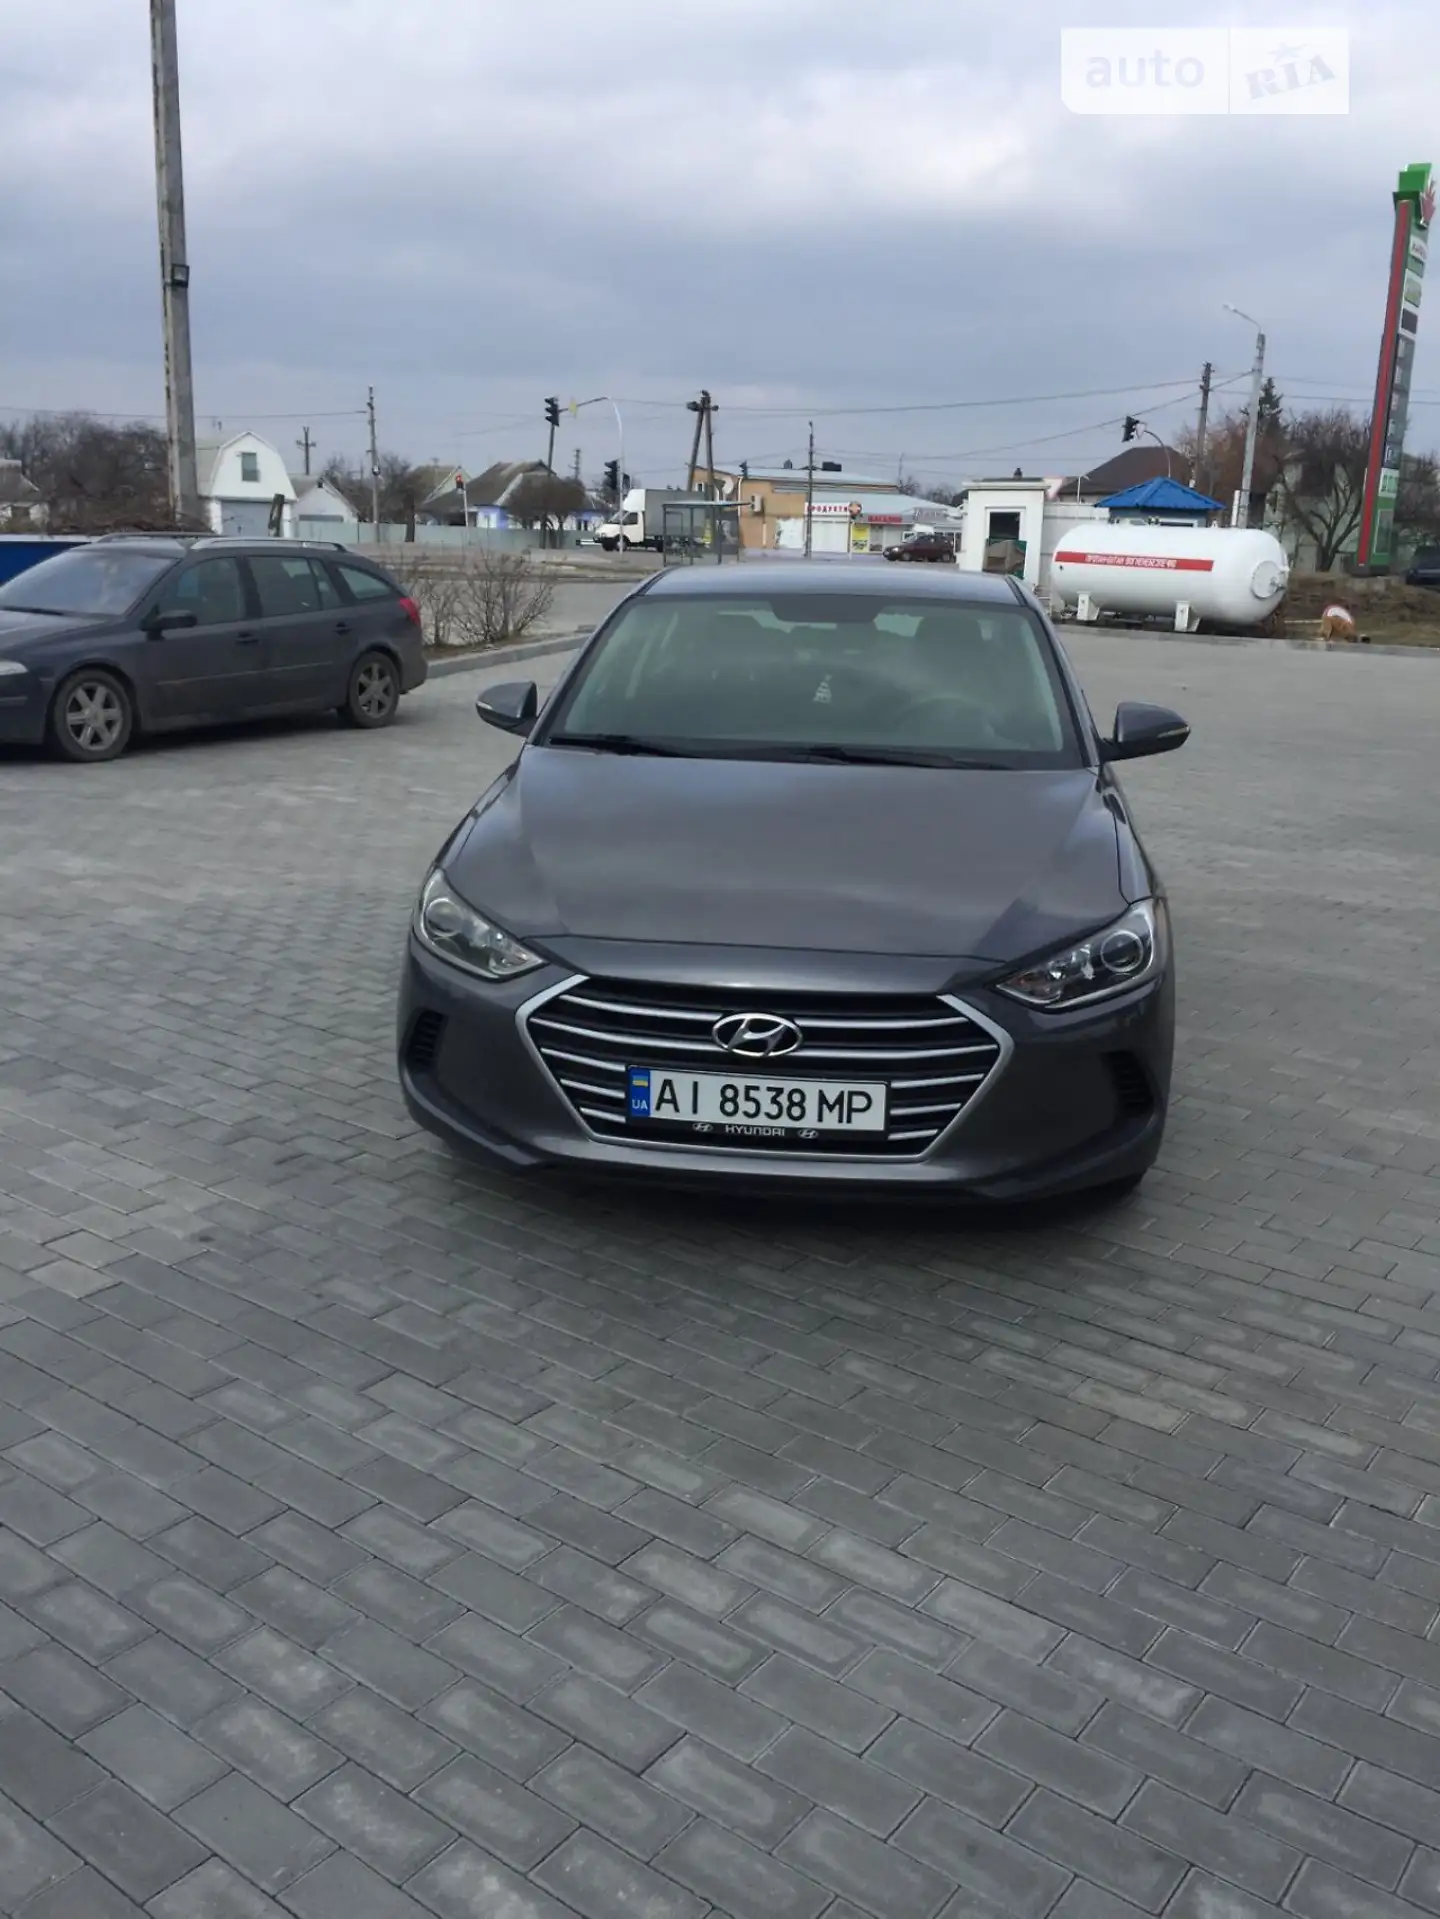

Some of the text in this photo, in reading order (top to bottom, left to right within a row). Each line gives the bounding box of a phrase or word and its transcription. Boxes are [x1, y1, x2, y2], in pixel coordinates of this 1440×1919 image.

[631, 1099, 648, 1111] UA
[655, 1078, 872, 1125] AI 8538 MP
[724, 1124, 785, 1137] HYUNDAI
